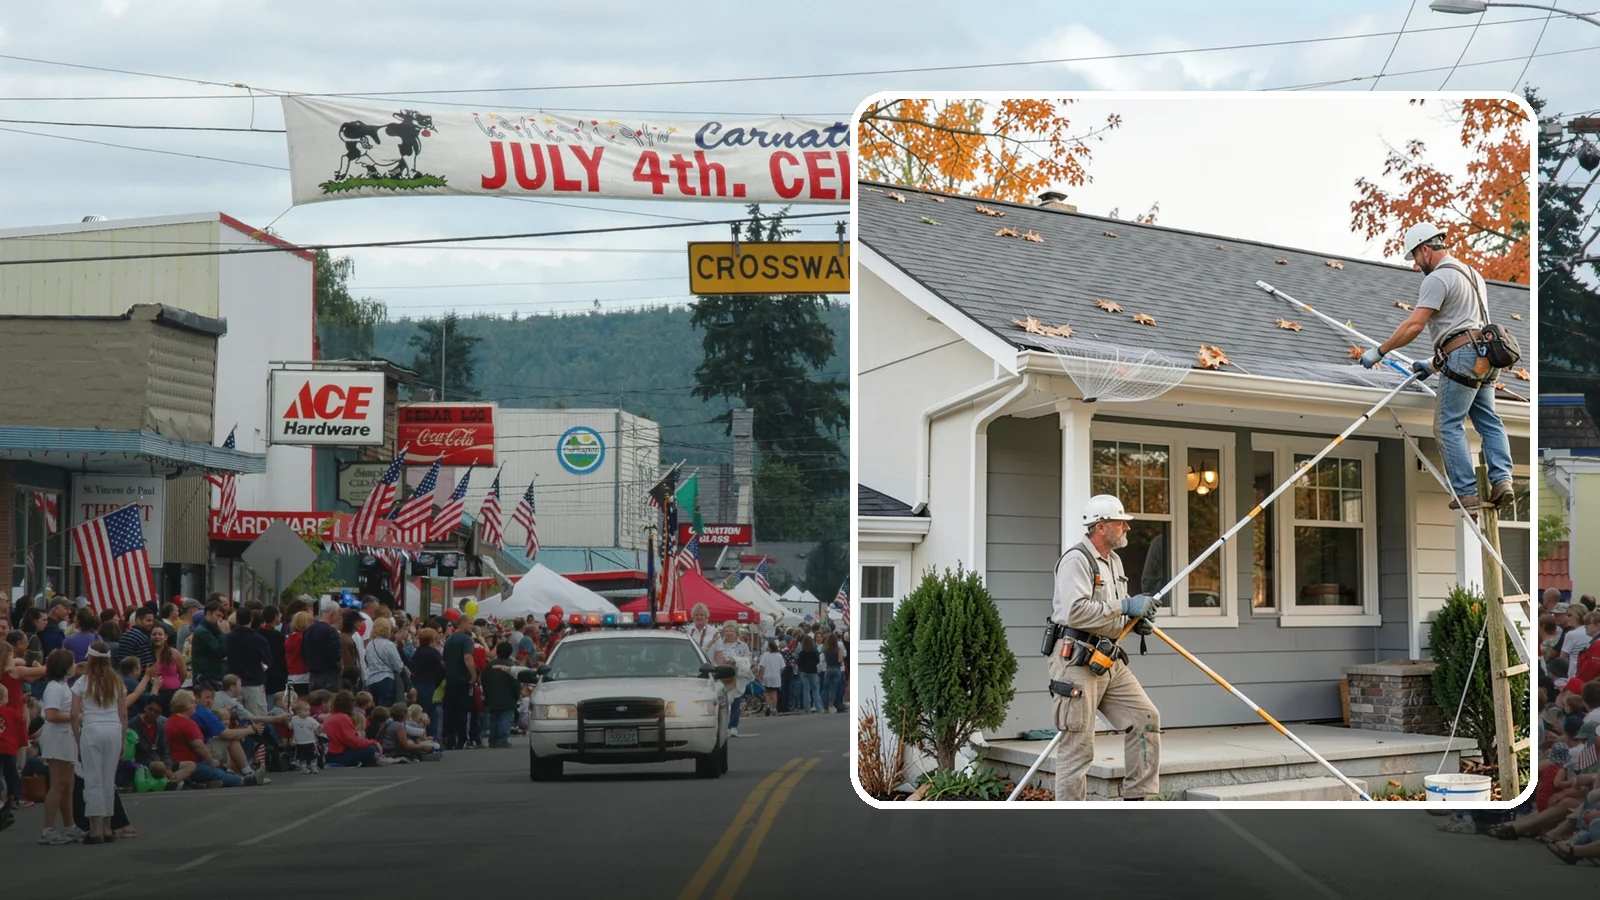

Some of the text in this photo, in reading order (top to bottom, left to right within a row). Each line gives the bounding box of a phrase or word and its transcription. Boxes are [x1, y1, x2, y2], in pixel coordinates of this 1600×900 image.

[481, 141, 604, 192] JULY
[632, 150, 746, 198] 4th.
[697, 254, 850, 280] CROSSWA
[283, 380, 373, 420] ACE
[405, 409, 452, 422] CEDAR
[283, 421, 371, 436] Hardware
[416, 428, 476, 447] Coca-Cola
[96, 486, 124, 495] Vincent
[126, 487, 136, 495] de
[138, 487, 155, 495] Paul
[699, 535, 730, 543] GLASS
